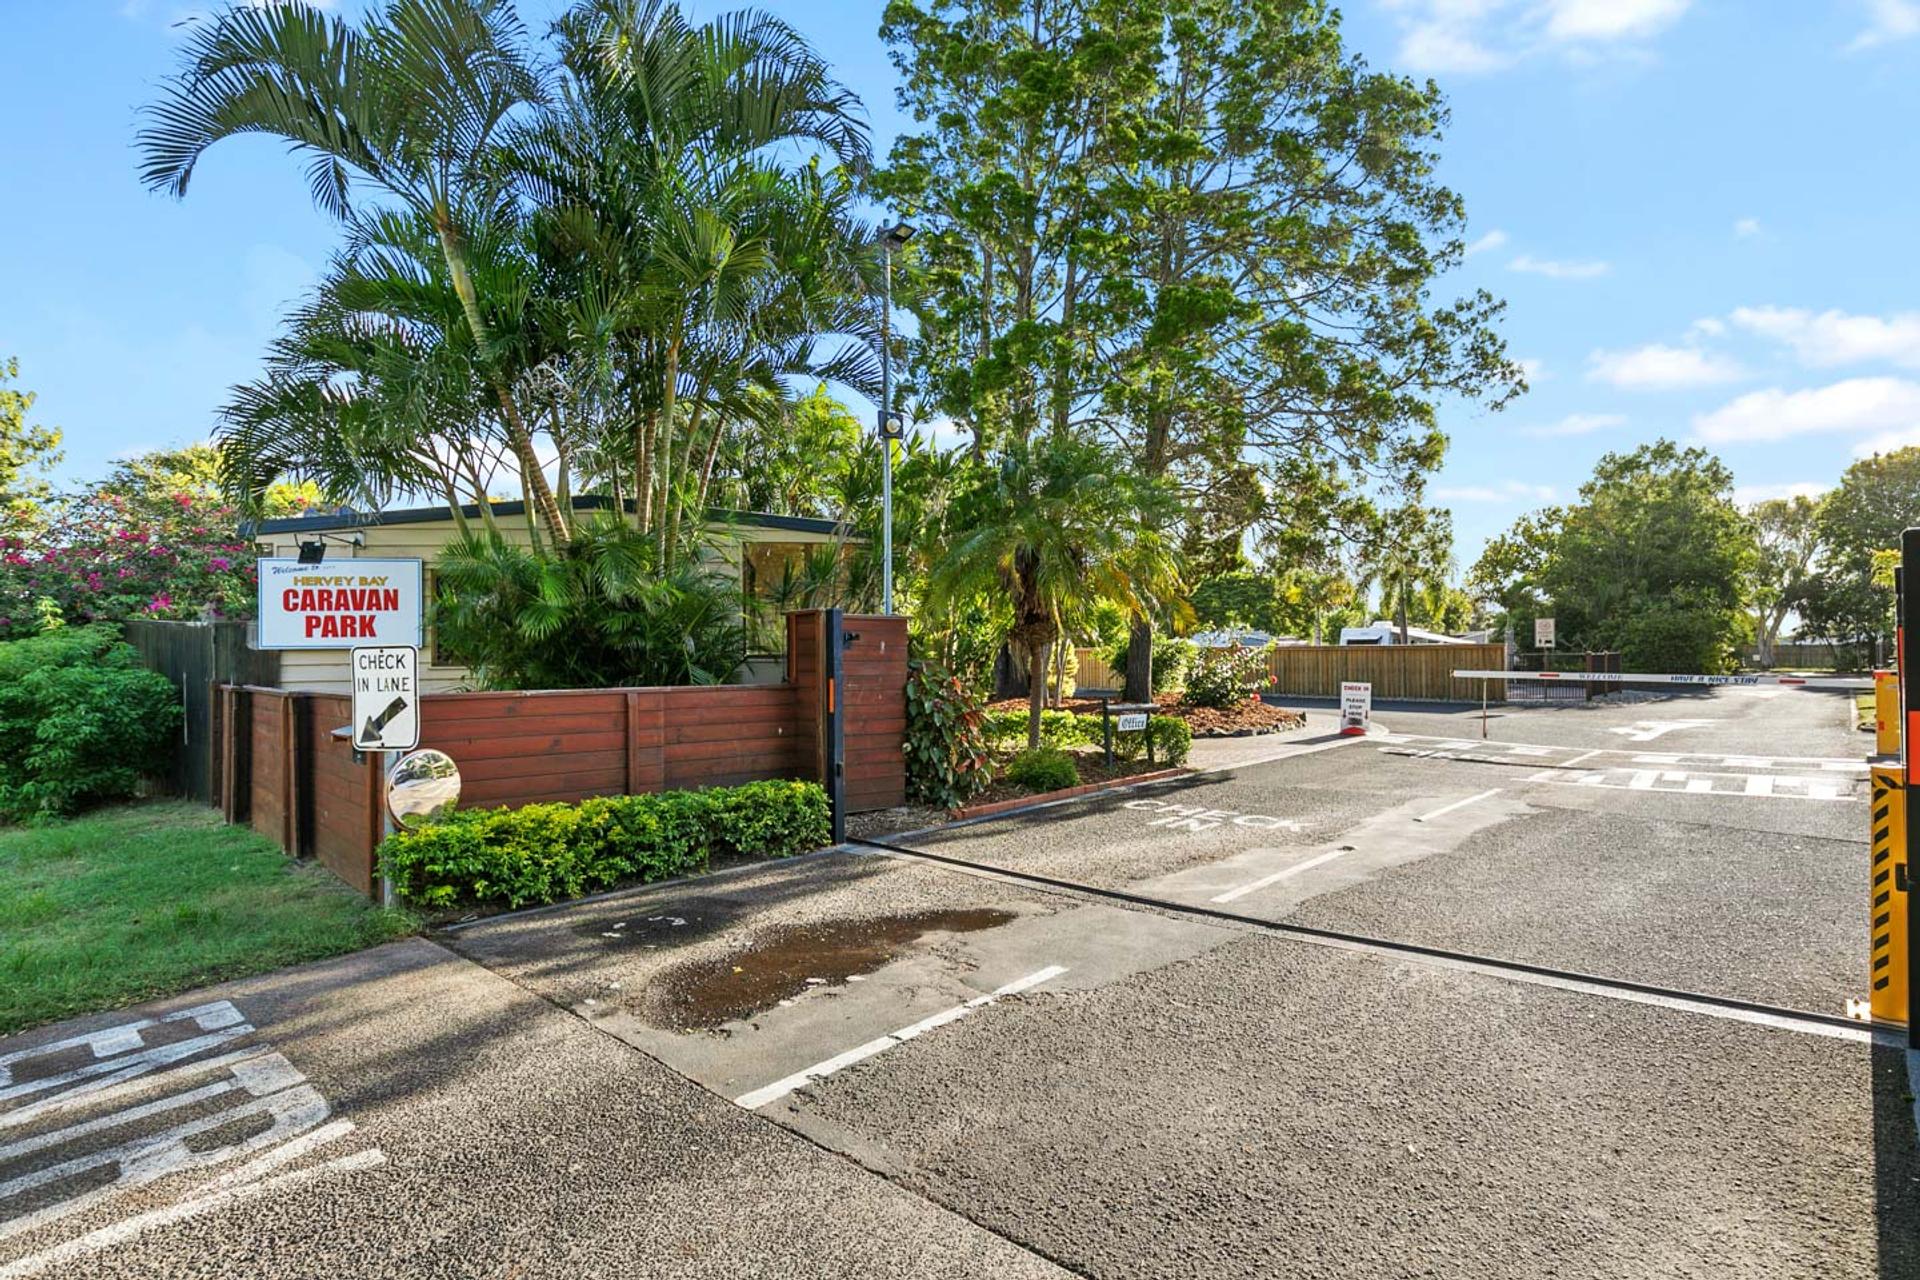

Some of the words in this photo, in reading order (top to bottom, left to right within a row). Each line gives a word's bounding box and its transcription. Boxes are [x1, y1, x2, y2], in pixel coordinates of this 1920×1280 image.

[272, 566, 307, 575] Welcome
[293, 576, 355, 586] HERVEY
[359, 576, 389, 586] BAY
[282, 589, 399, 611] CARAVAN
[305, 615, 377, 638] PARK
[359, 654, 406, 670] CHECK
[357, 677, 370, 692] IN
[377, 677, 411, 692] LANE
[1670, 675, 1693, 683] HAVE
[1708, 676, 1729, 684] NICE
[1733, 676, 1759, 684] STAY
[1121, 717, 1145, 729] Office
